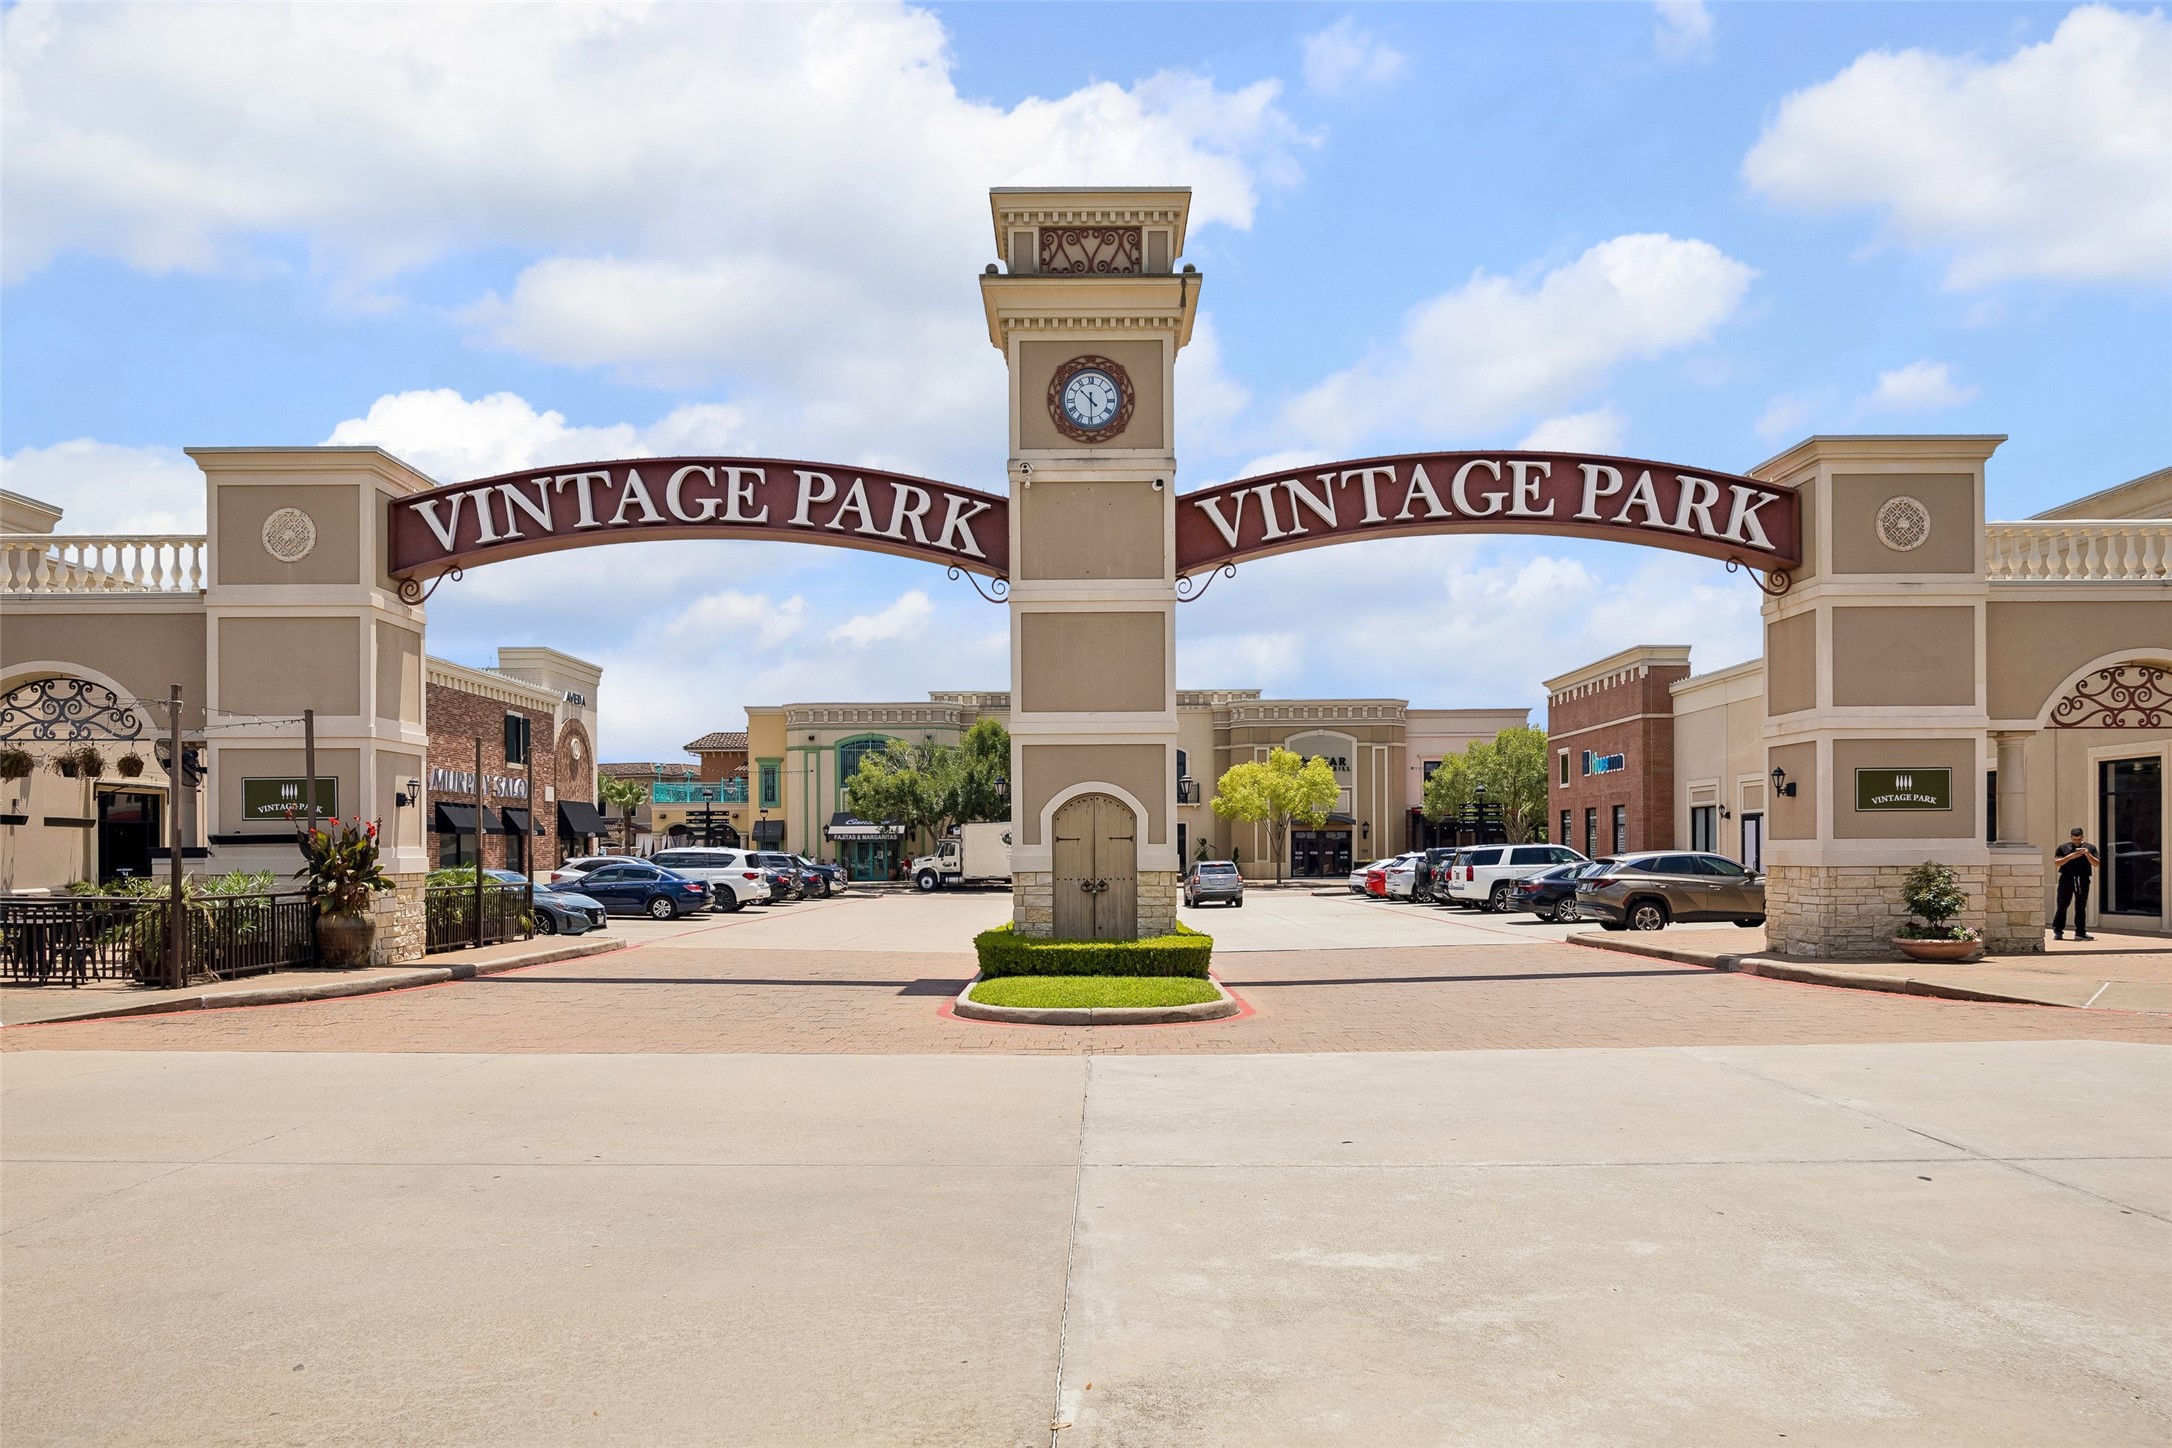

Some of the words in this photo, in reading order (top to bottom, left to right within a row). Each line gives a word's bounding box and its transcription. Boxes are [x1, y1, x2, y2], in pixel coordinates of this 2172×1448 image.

[409, 465, 769, 552] VINTAGE
[787, 469, 992, 559] PARK
[1194, 459, 1556, 549] VINTAGE
[1576, 462, 1780, 551] PARK
[563, 690, 587, 708] AVEDA
[429, 768, 490, 796] MURPY
[493, 775, 530, 799] SALO
[299, 803, 323, 814] PAK
[1871, 793, 1912, 805] VINTAGE
[1913, 793, 1937, 805] PARK
